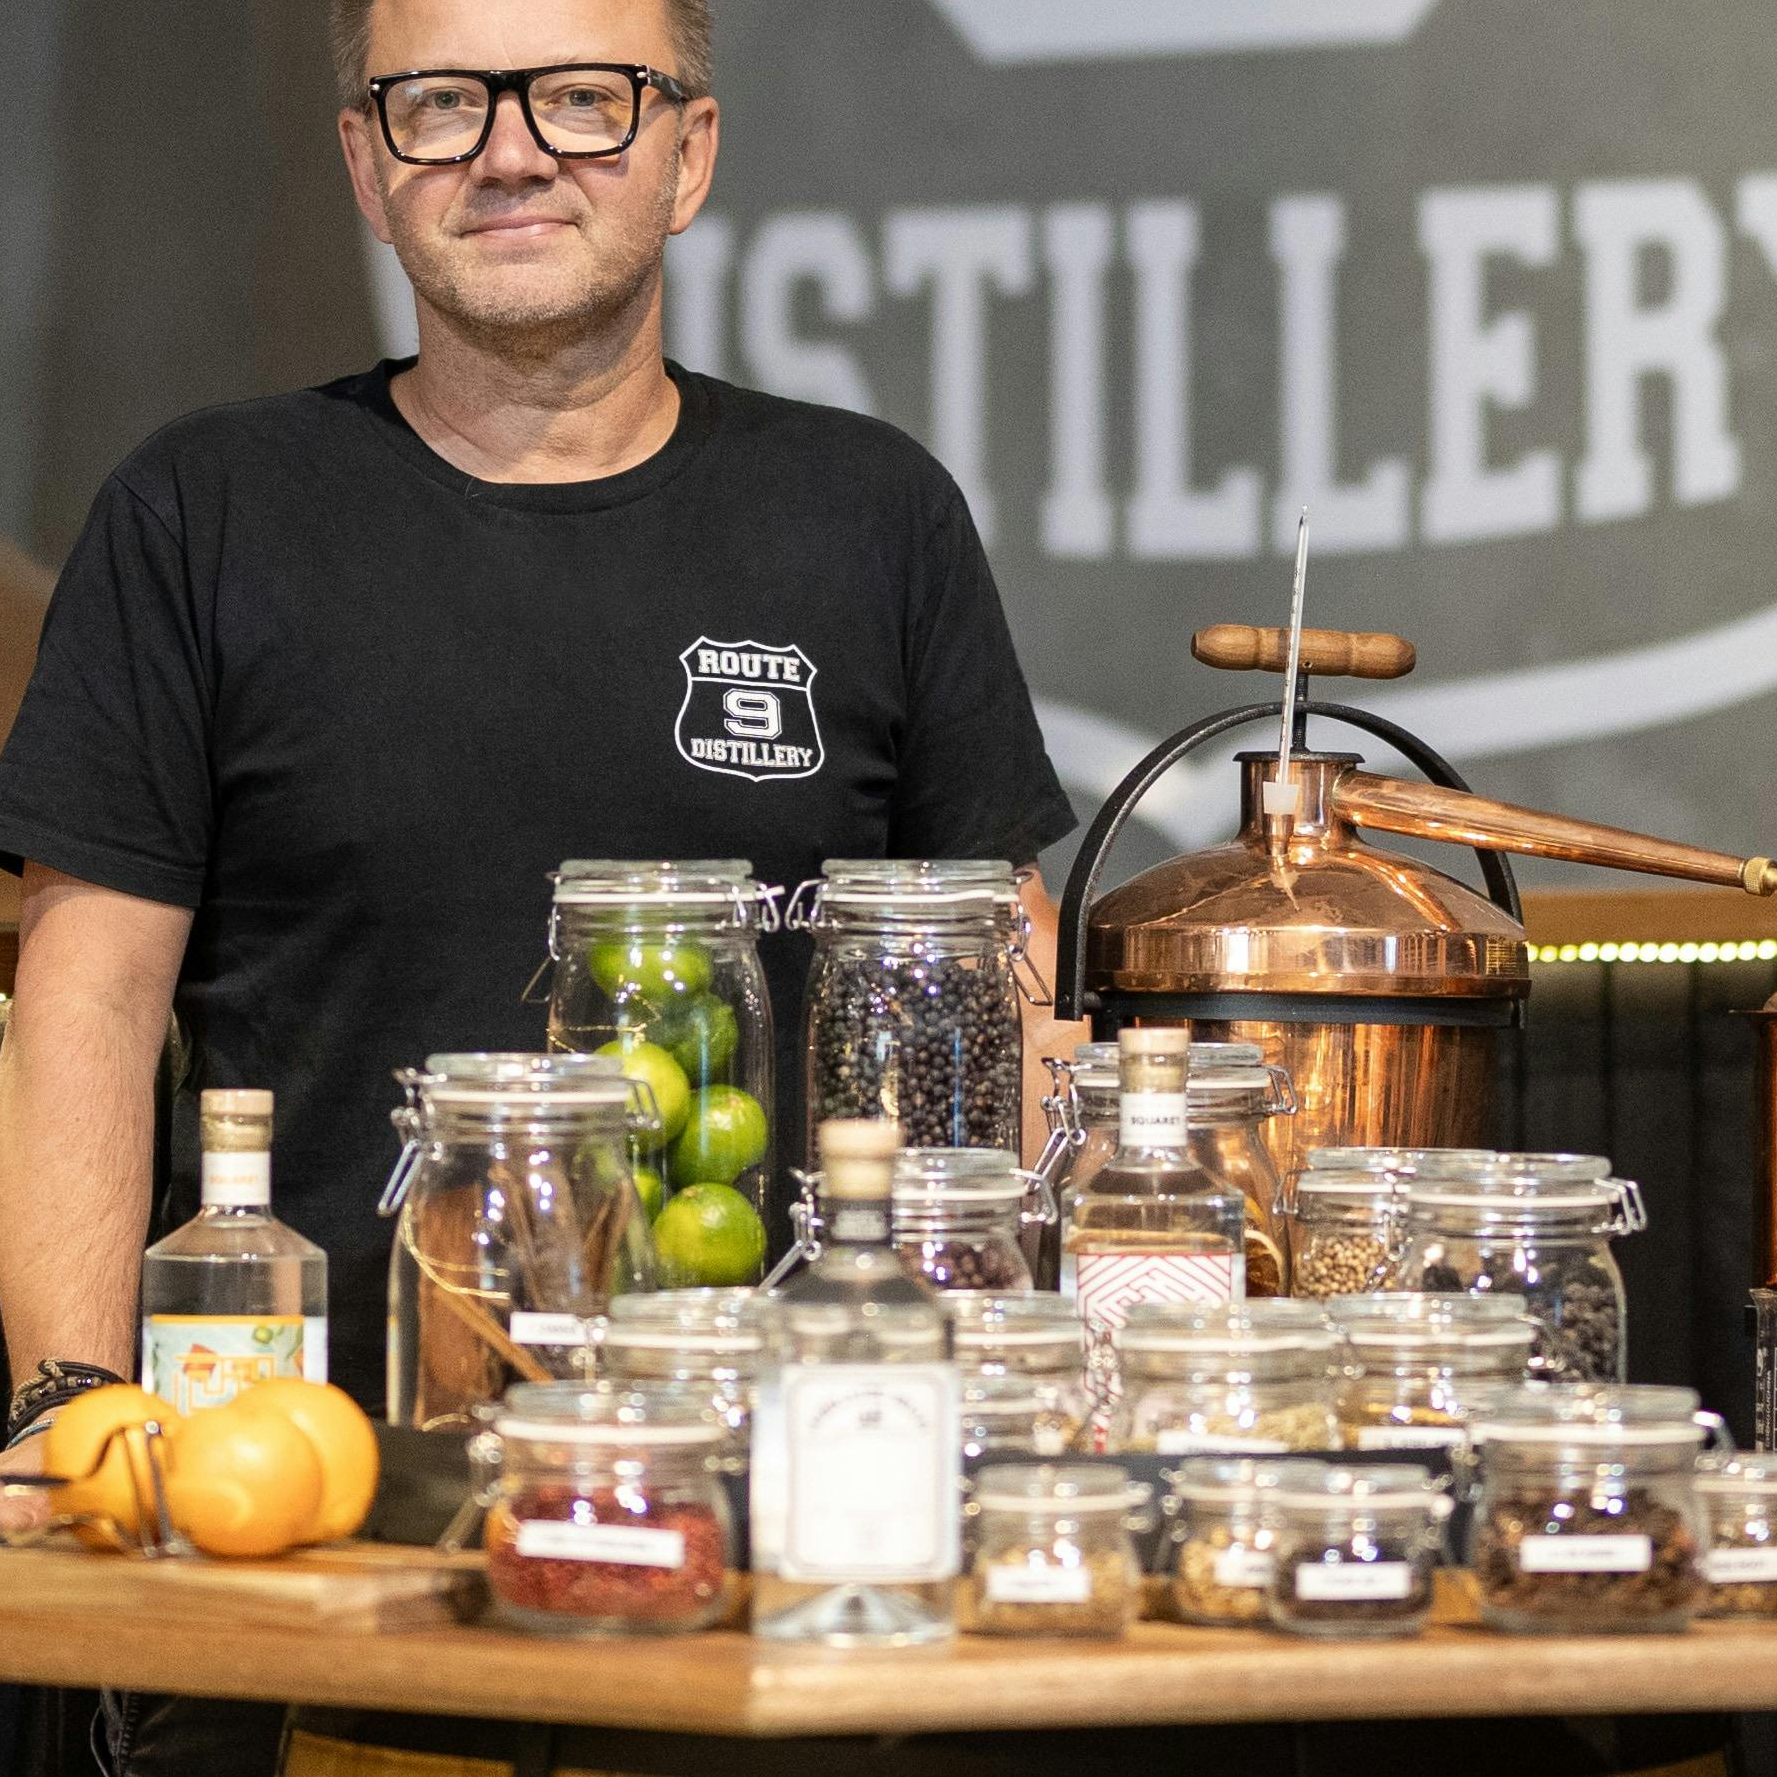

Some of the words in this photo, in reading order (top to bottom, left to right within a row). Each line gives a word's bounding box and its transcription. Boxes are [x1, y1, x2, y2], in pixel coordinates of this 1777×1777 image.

[697, 648, 801, 682] ROUTE
[722, 687, 783, 740] 9
[689, 737, 814, 768] DISTILLERY
